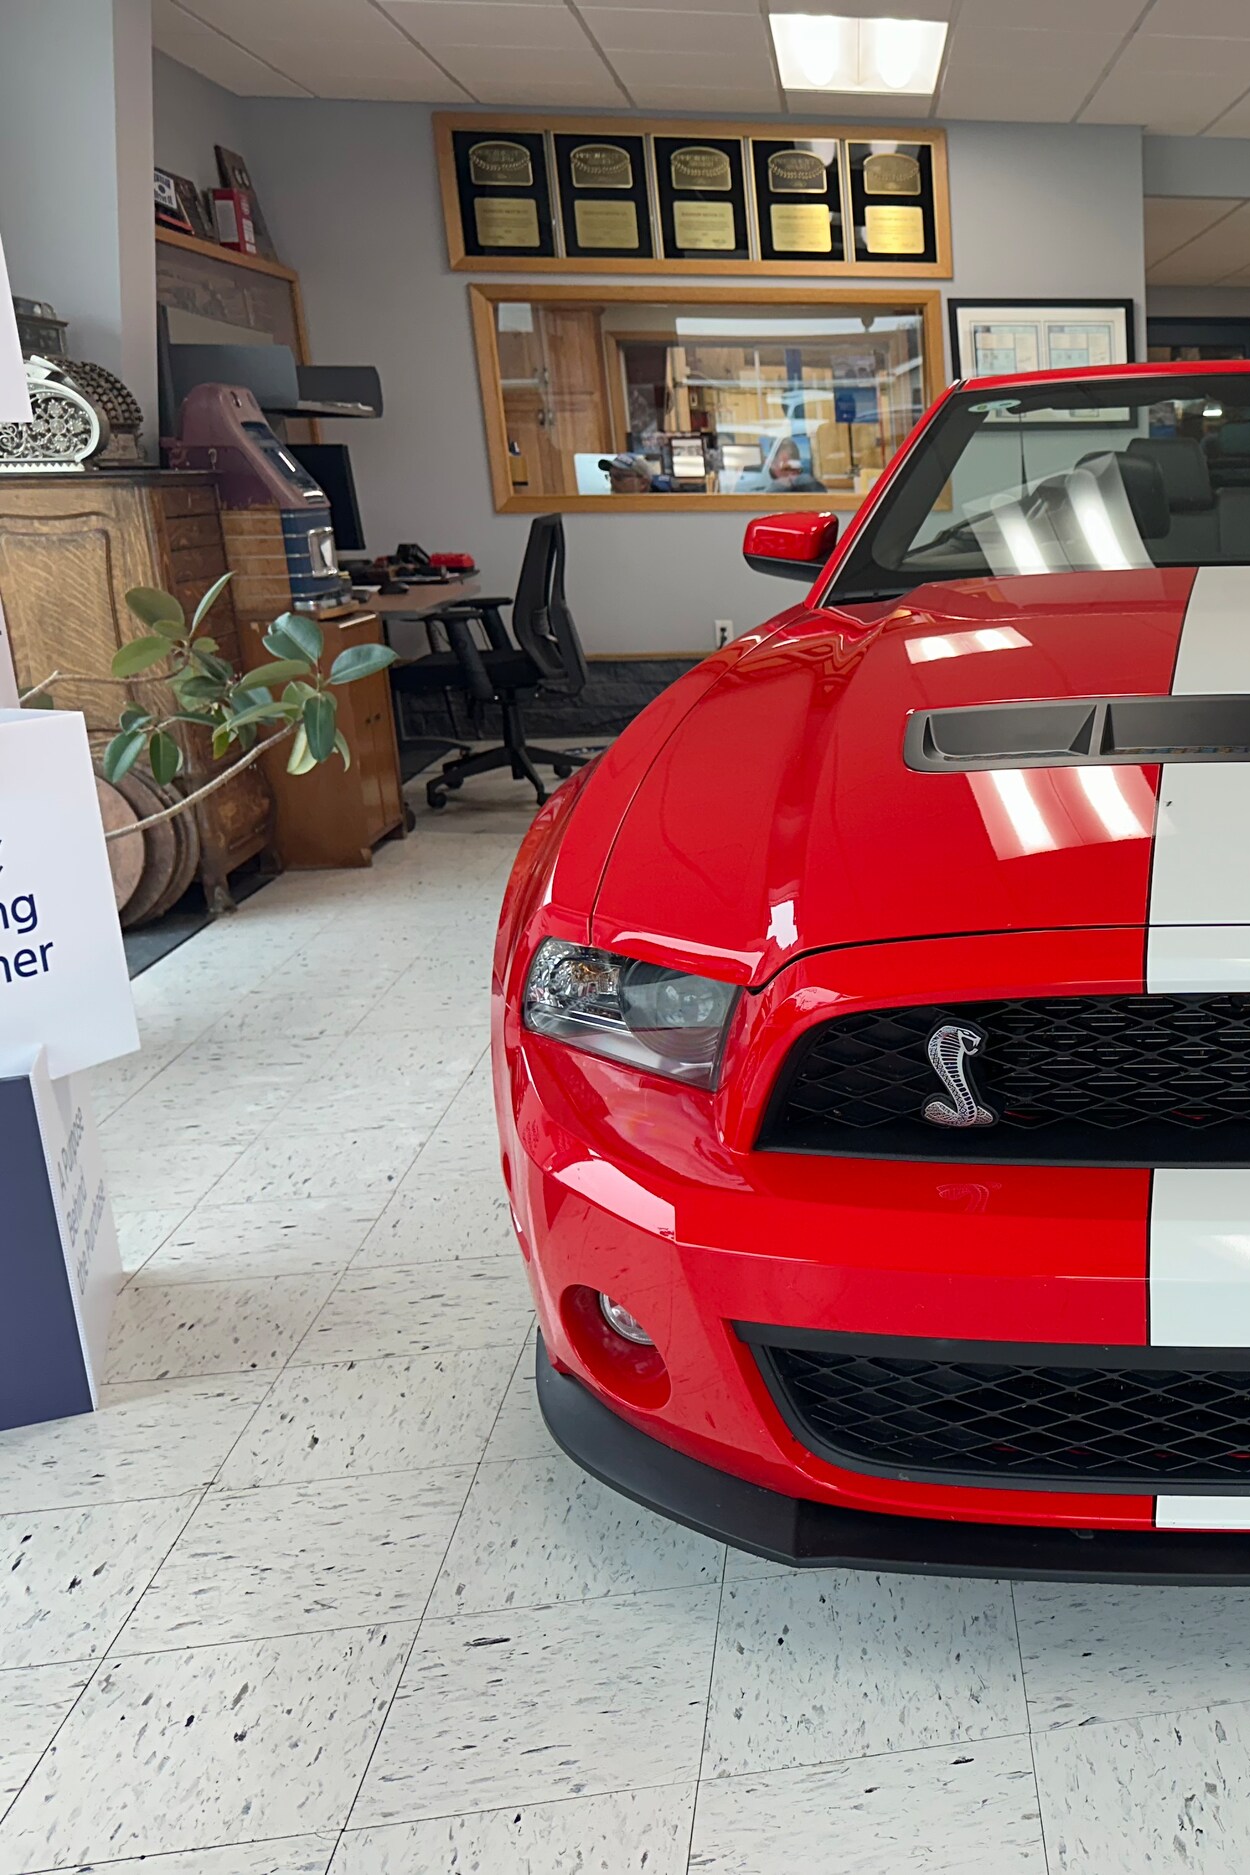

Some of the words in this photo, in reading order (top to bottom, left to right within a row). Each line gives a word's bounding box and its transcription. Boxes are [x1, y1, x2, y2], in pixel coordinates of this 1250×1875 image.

[61, 1106, 84, 1183] Purpose
[66, 1164, 87, 1248] Behind
[76, 1250, 89, 1295] the
